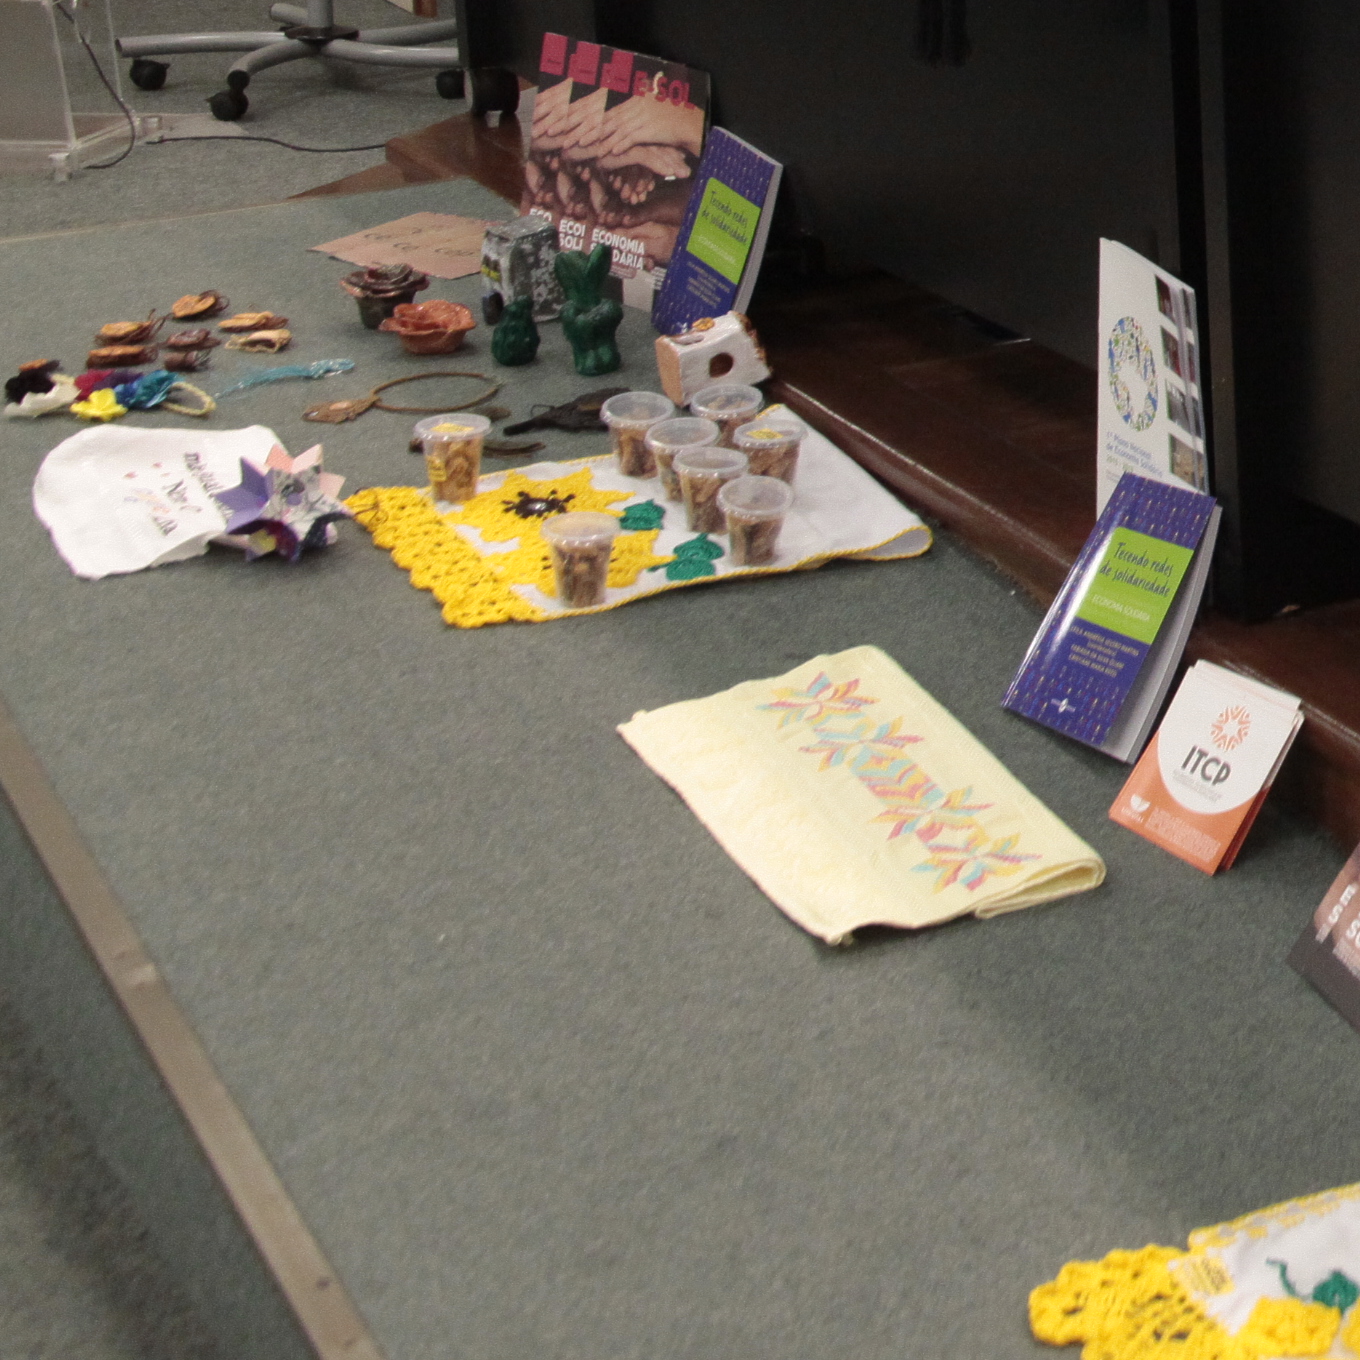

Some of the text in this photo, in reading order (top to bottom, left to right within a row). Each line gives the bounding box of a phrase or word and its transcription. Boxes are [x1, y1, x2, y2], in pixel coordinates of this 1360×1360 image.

[591, 228, 645, 255] ECONOMIA
[1114, 542, 1174, 578] Tecendo redes
[1100, 561, 1170, 597] de solidariedade
[1181, 745, 1232, 786] ITCP
